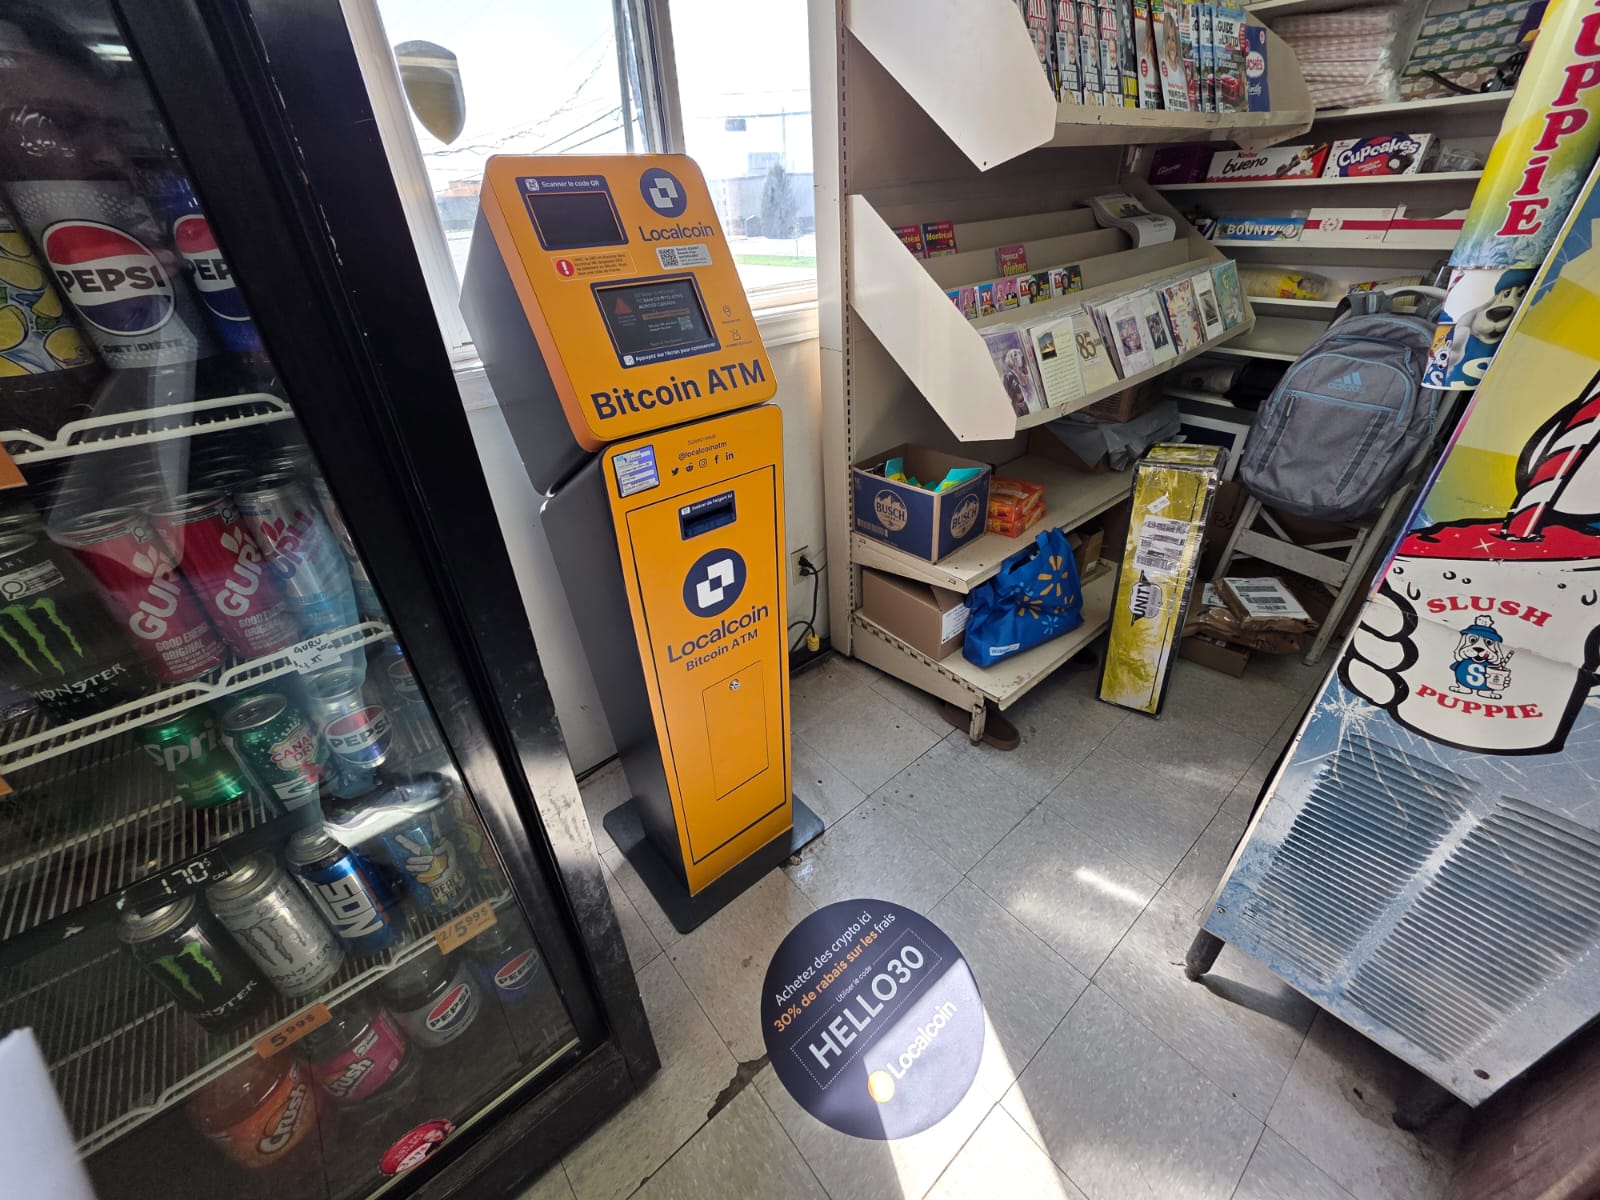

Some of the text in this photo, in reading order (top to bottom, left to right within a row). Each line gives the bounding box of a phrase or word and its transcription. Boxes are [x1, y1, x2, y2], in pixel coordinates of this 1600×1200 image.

[1223, 158, 1268, 174] bueno
[1338, 138, 1419, 166] Cupcakes
[638, 221, 714, 242] Localcoin
[1227, 223, 1284, 236] BOUNTY
[56, 266, 165, 293] PEPSI
[189, 259, 232, 281] PEP
[591, 360, 765, 420] Bitcoin ATM
[1328, 382, 1367, 393] adidas
[679, 441, 727, 460] @localcoinatm
[876, 502, 905, 521] BUSCH
[952, 508, 977, 530] BUSCH
[1131, 571, 1151, 625] UNITY
[1427, 596, 1552, 627] SLUSH
[155, 635, 183, 651] GOOD
[667, 605, 768, 663] Localcoin
[686, 629, 758, 671] Bitcoin ATM
[1466, 663, 1485, 686] S
[1416, 684, 1543, 719] PUPPIE
[144, 719, 217, 771] Spri
[329, 716, 390, 748] PEPSI
[212, 870, 228, 882] CAN
[774, 912, 896, 1032] 30% de rabais sur les frais
[775, 910, 873, 1006] Achetez des crypto ici
[835, 982, 855, 1003] Utiliser
[859, 965, 873, 979] code
[430, 988, 470, 1028] PEPSI
[808, 945, 924, 1070] HELLO30
[886, 1001, 958, 1079] Localcoin
